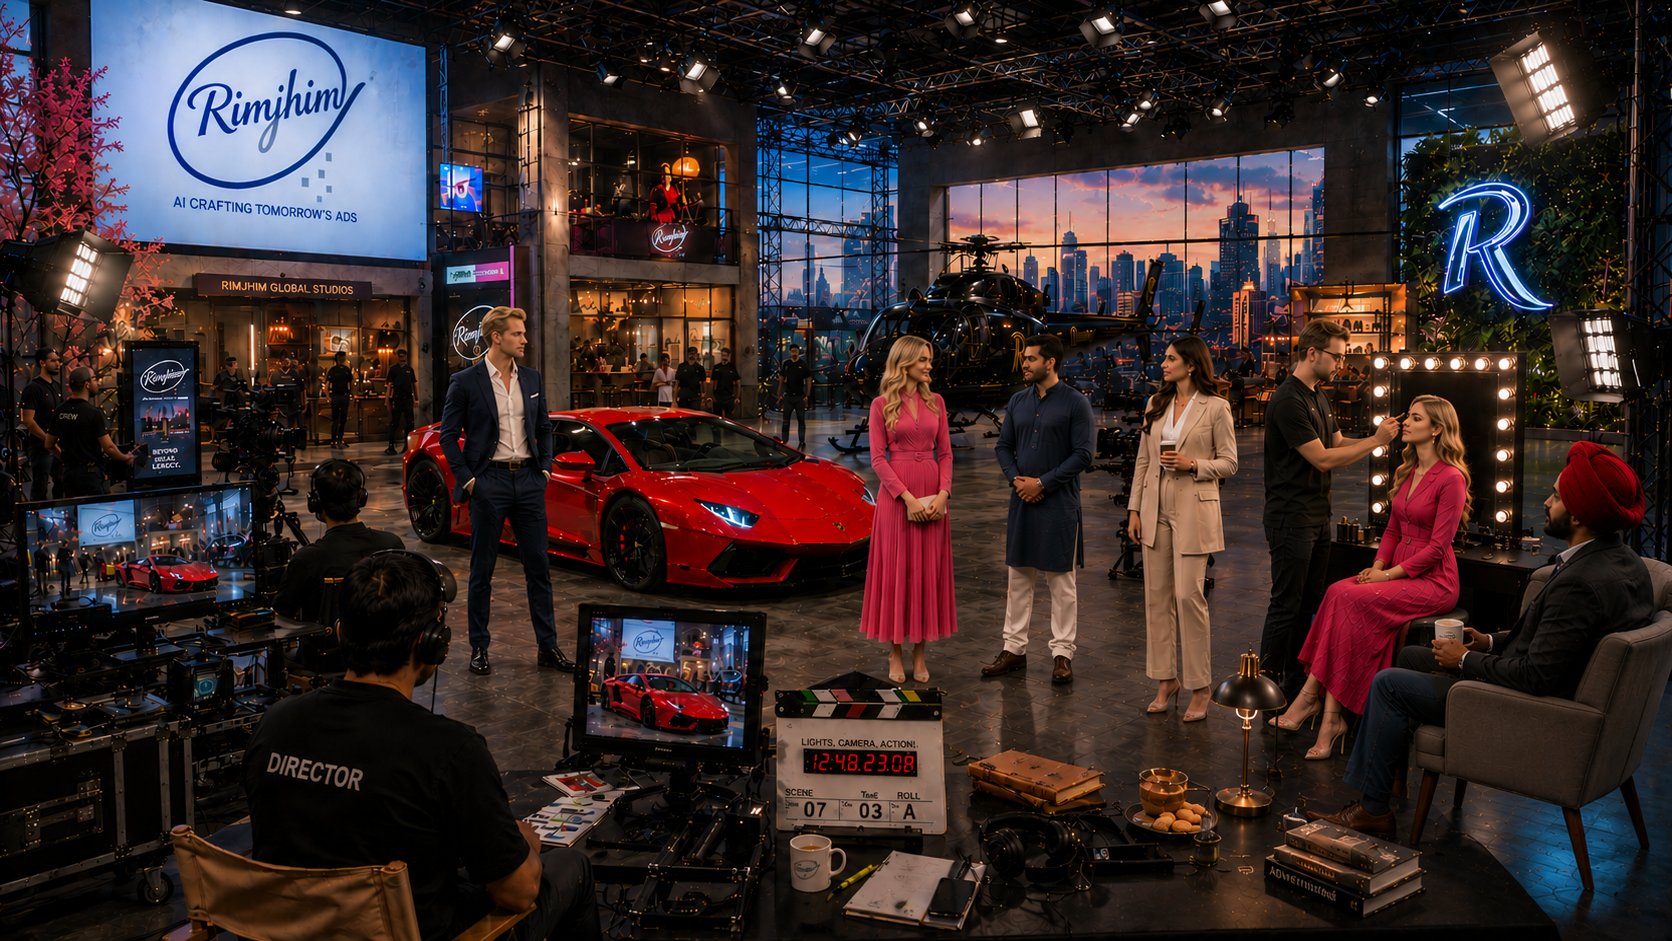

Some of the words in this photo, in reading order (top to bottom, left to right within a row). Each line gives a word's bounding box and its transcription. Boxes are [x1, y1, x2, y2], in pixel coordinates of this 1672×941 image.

[187, 68, 341, 153] Rimjhim
[173, 196, 186, 208] AI
[189, 198, 252, 214] CRAFTING
[255, 204, 332, 221] TOMORROW'S
[335, 212, 357, 223] ADS
[1438, 182, 1553, 311] R
[221, 281, 267, 292] RIMJHIM
[270, 282, 311, 294] GLOBAL
[313, 285, 354, 295] STUDIOS
[801, 738, 835, 747] LIGHTS,
[838, 739, 878, 748] CAMERA,
[266, 752, 364, 791] DIRECTOR
[785, 788, 813, 797] SCENE
[897, 792, 921, 800] ROLL
[804, 801, 827, 817] 07
[859, 802, 883, 819] 03
[903, 804, 916, 820] A
